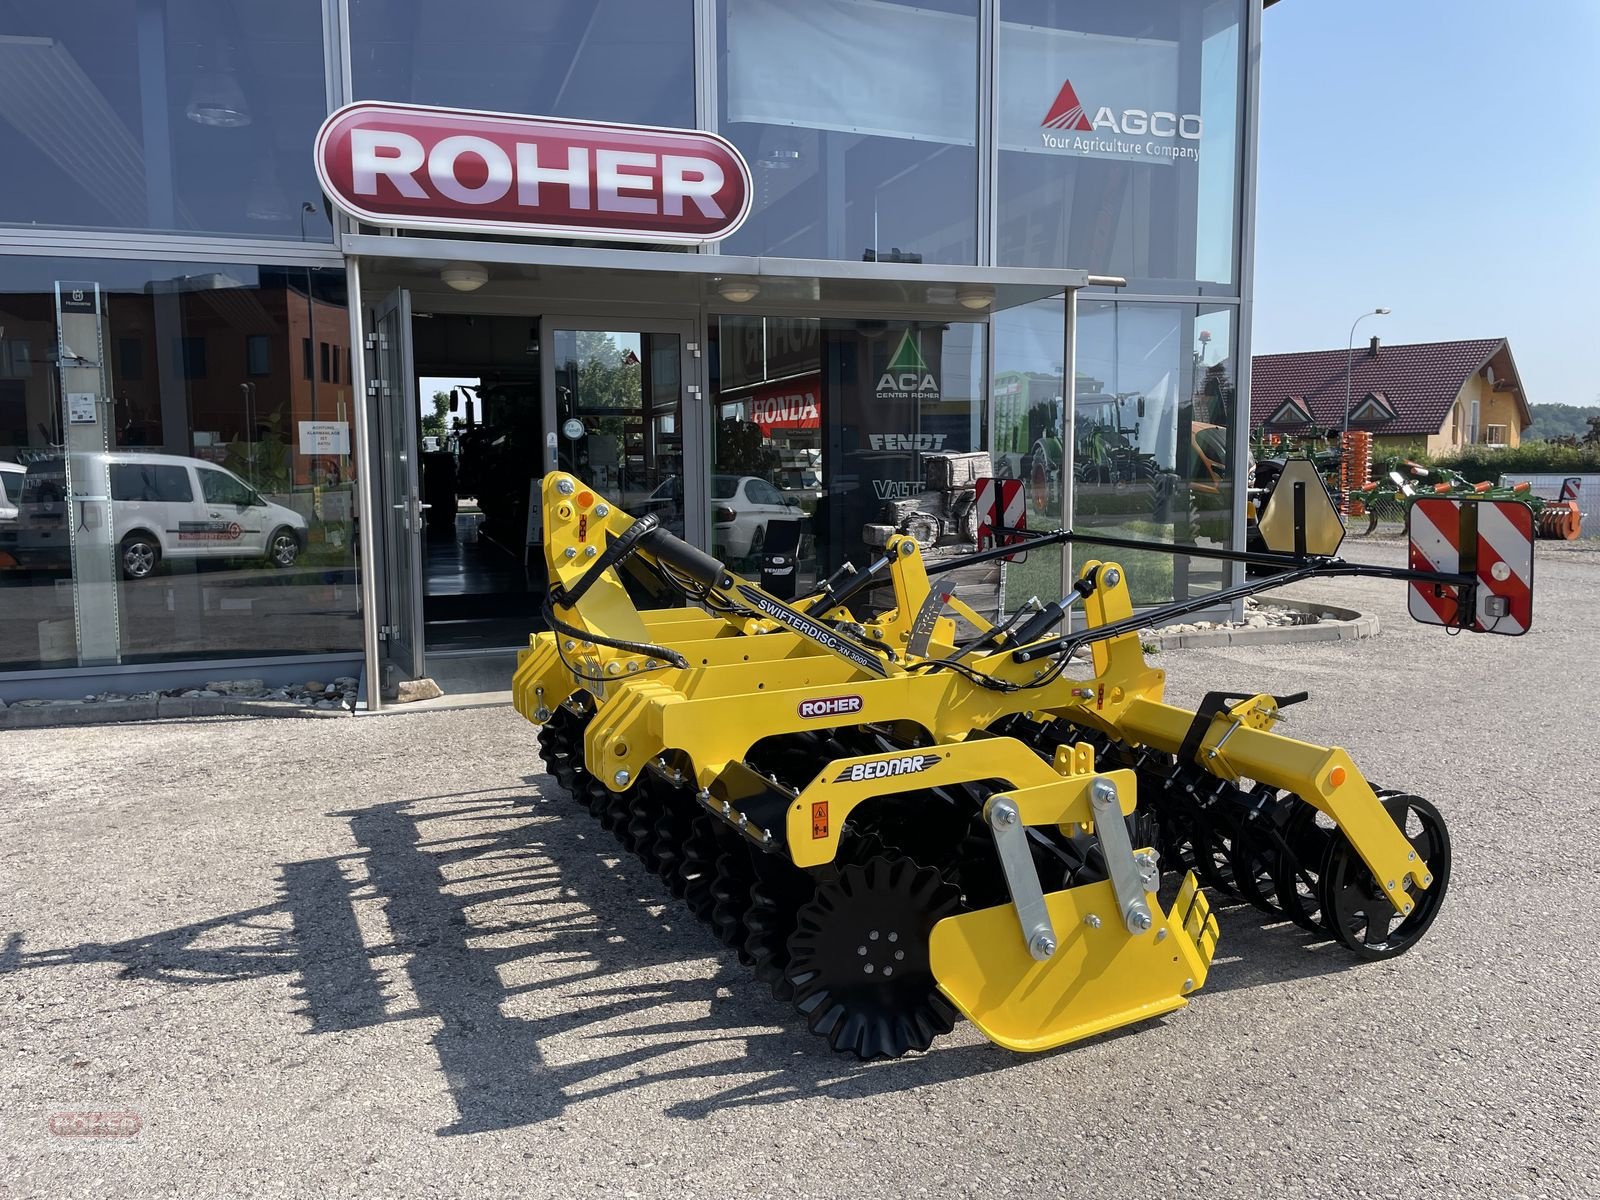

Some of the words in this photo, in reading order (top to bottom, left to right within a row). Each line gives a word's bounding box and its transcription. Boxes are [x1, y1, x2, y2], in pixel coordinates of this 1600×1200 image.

[1092, 106, 1203, 140] AGCO
[1042, 133, 1069, 149] Your
[1073, 136, 1141, 154] Agriculture
[1145, 141, 1201, 162] Company
[350, 128, 727, 220] ROHER
[875, 373, 939, 392] ACA
[753, 393, 818, 424] HONDA
[868, 433, 947, 451] FENDT
[757, 599, 838, 649] SWIFTERDISC
[838, 645, 851, 658] XN
[850, 651, 868, 667] 3000
[801, 698, 860, 716] ROHER
[850, 755, 925, 782] BEDNAR
